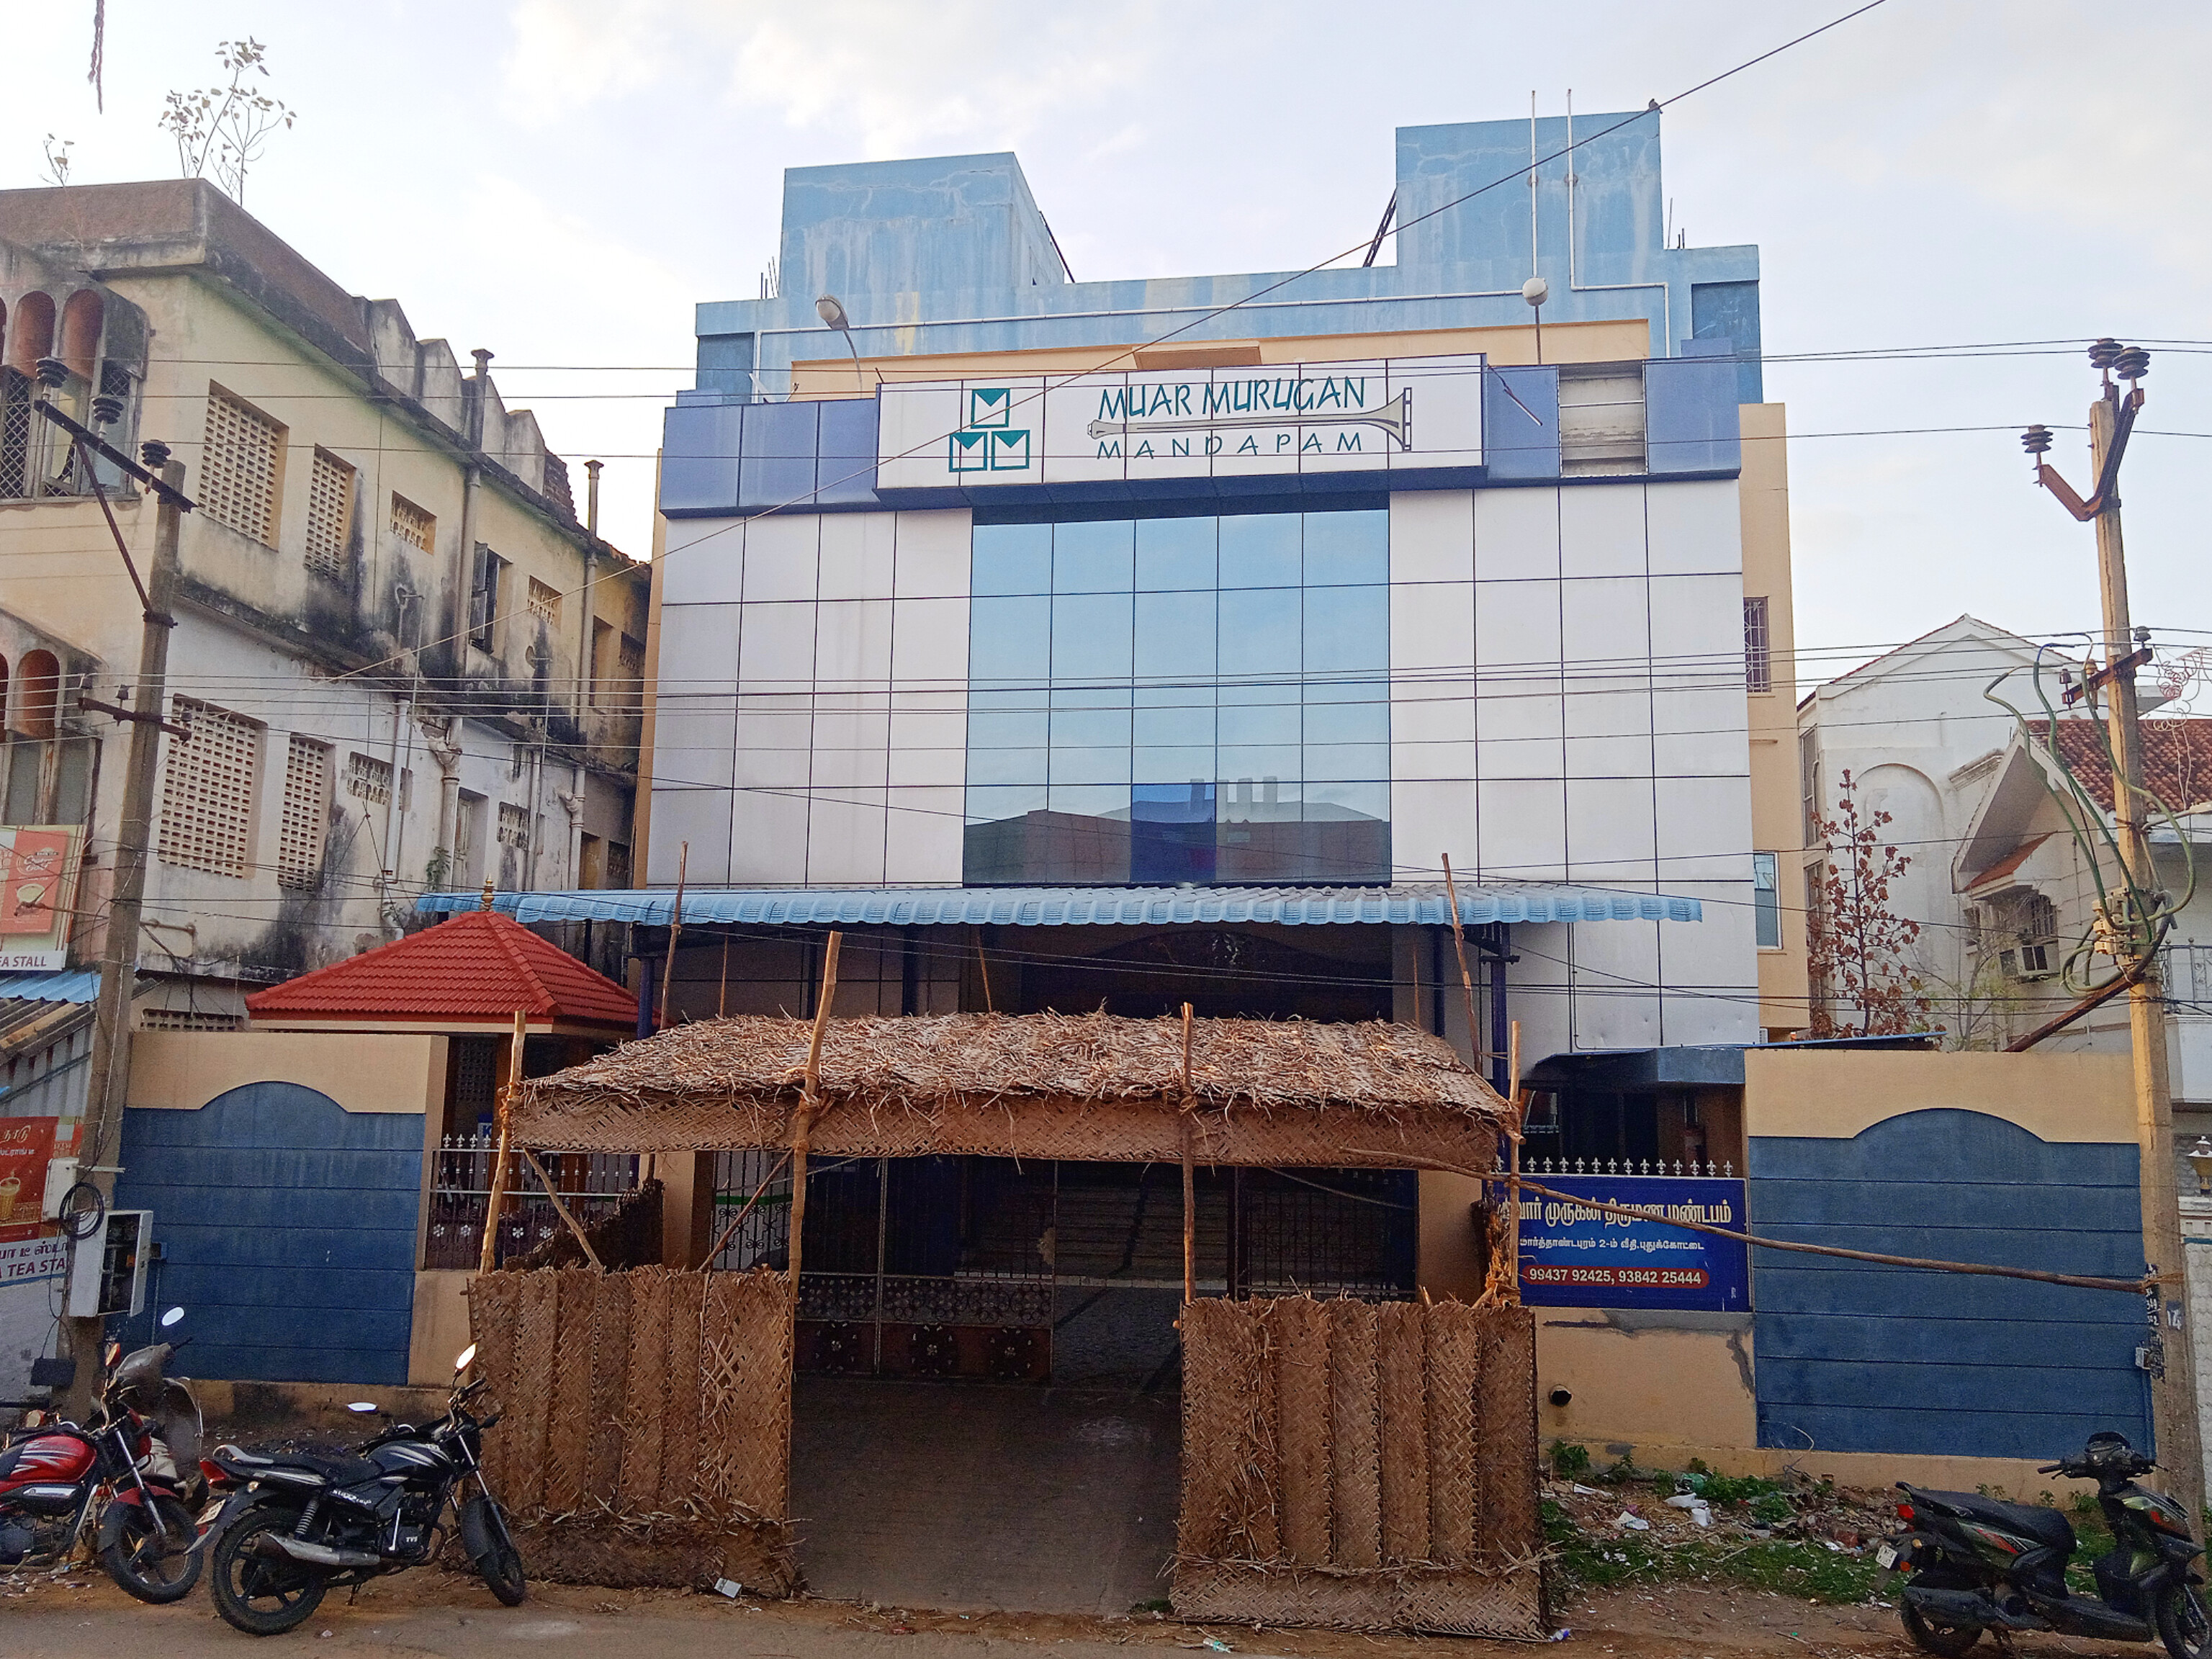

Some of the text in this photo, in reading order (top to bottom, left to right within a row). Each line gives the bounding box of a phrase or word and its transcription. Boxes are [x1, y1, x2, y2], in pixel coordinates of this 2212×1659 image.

[1098, 375, 1365, 420] MUAR MURUGAN
[1097, 432, 1362, 459] MANDAPAM
[12, 956, 47, 967] STALL
[1545, 1196, 1601, 1228] முருகன்
[1604, 1197, 1665, 1230] திருமண
[1668, 1198, 1732, 1224] மண்டபம்
[1599, 1237, 1618, 1249] 2-ம்
[7, 1261, 35, 1277] TEA
[1529, 1268, 1701, 1285] 99437 92425, 93842 25444
